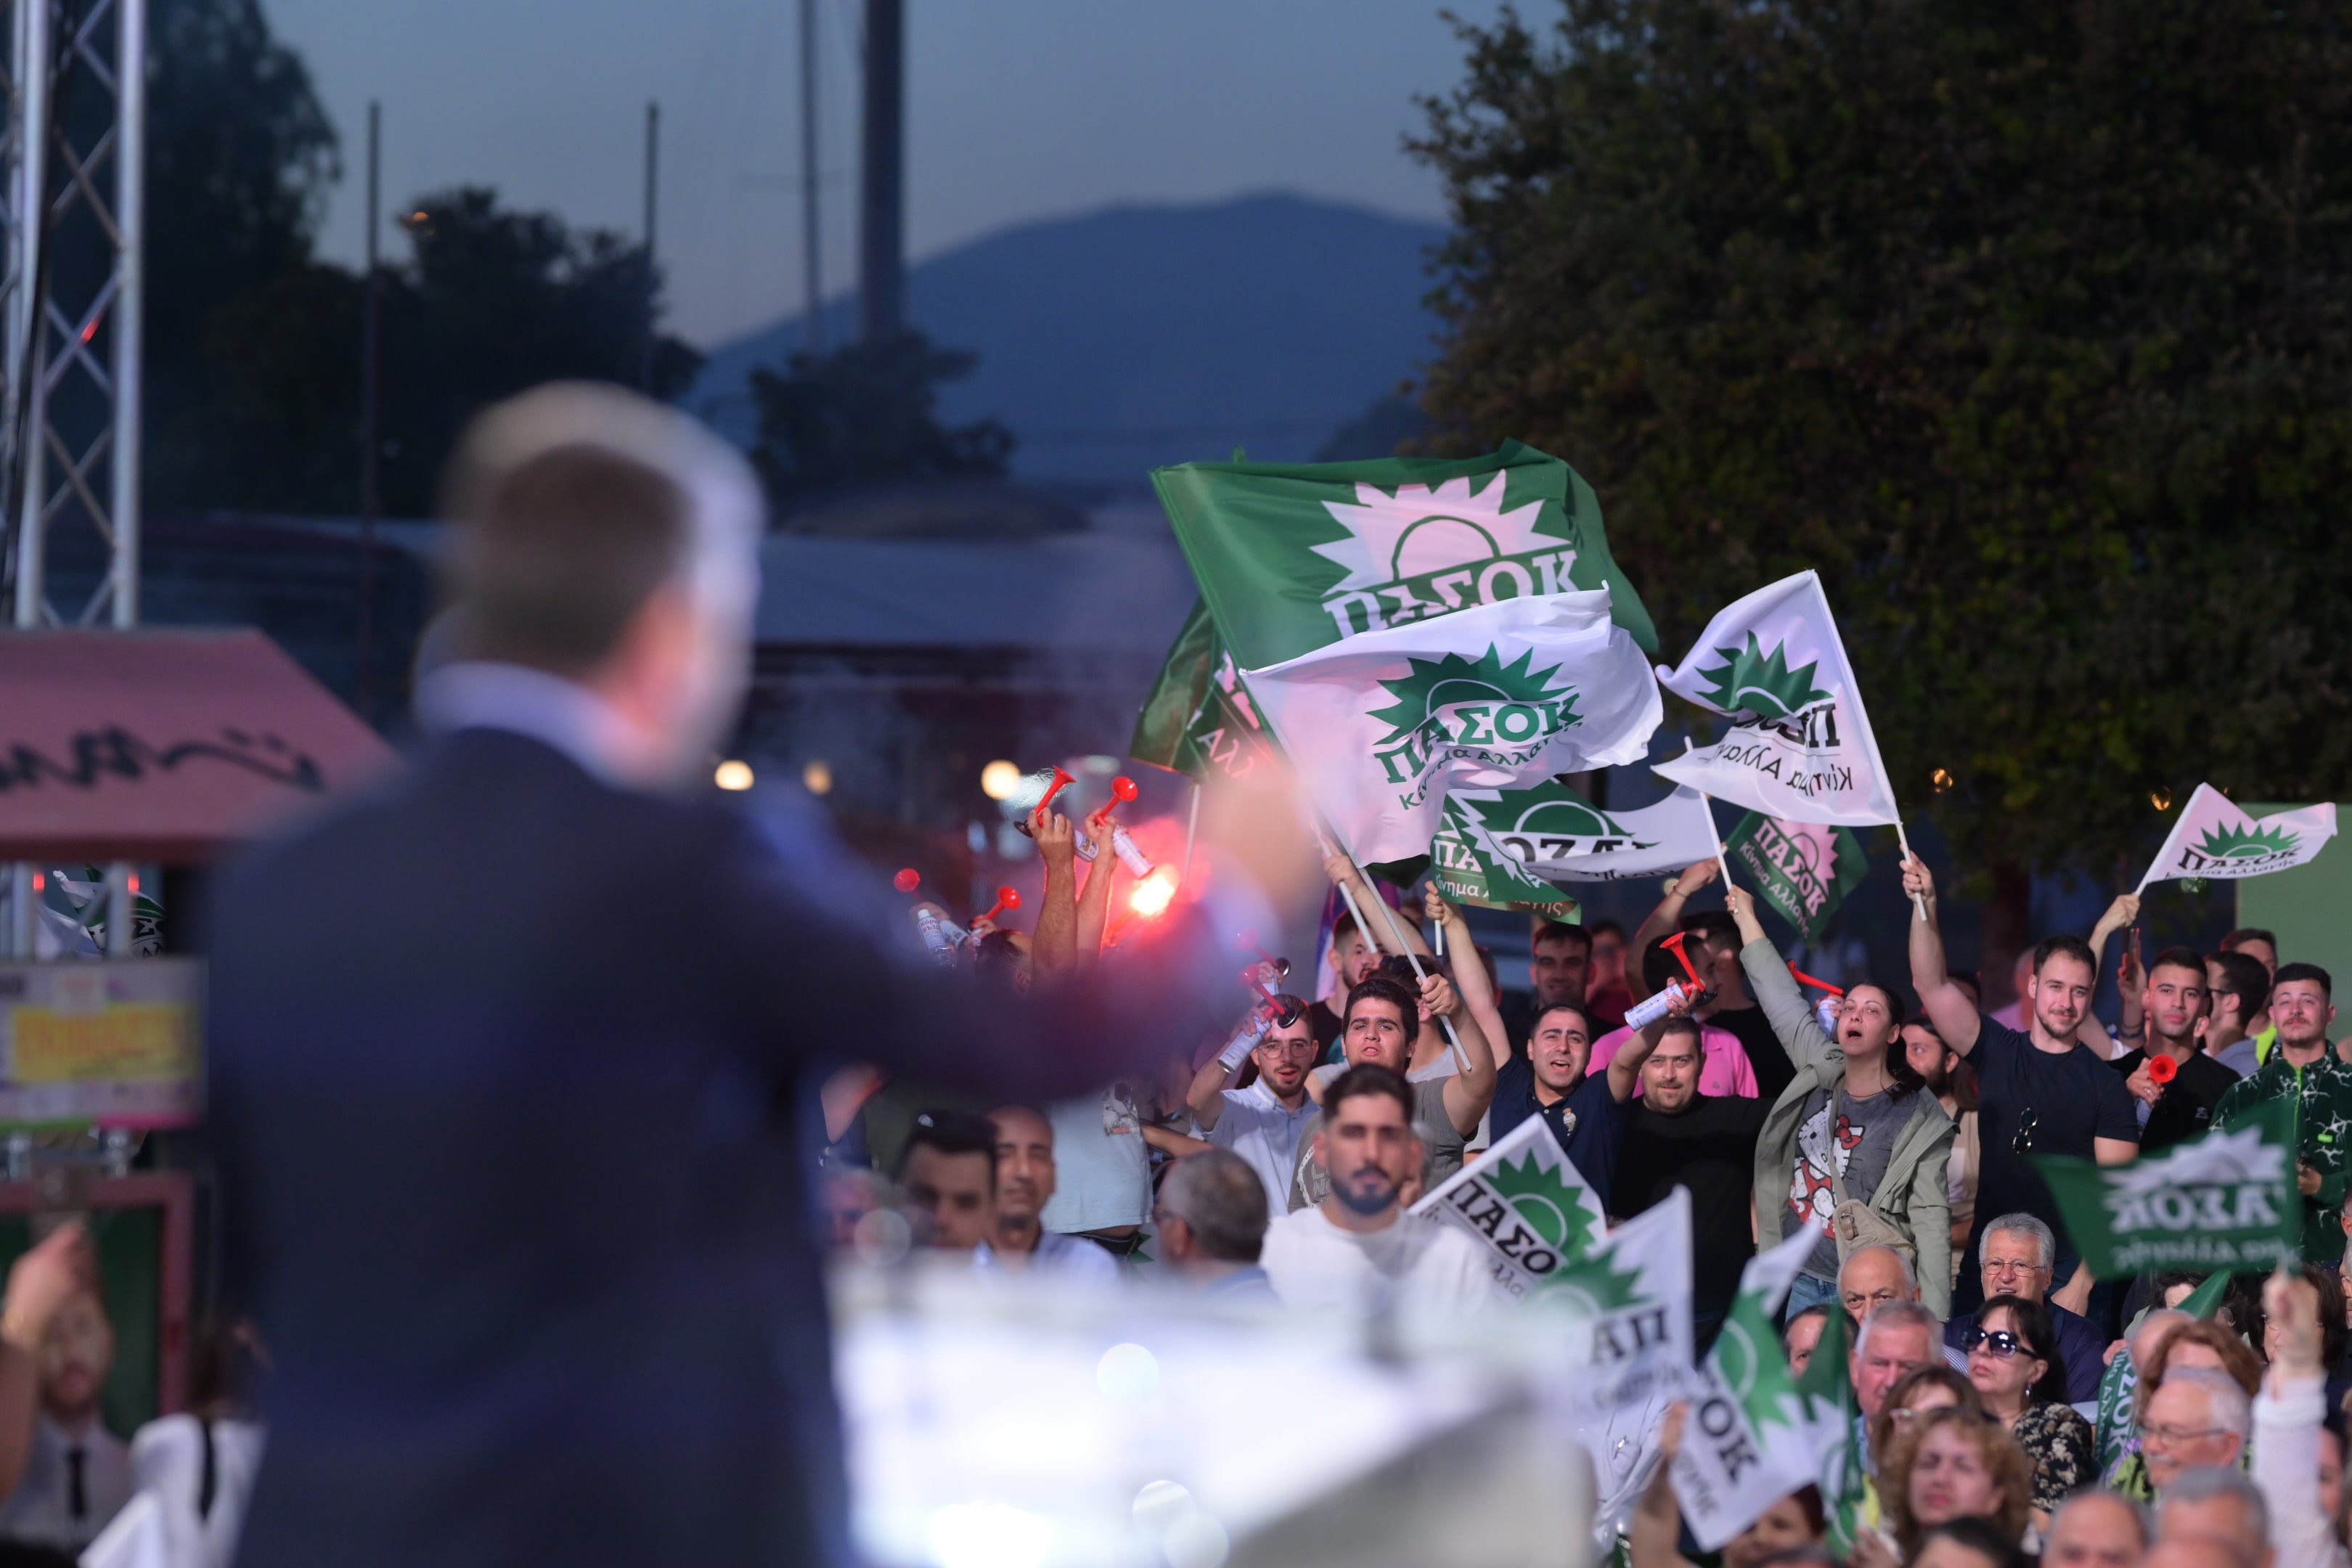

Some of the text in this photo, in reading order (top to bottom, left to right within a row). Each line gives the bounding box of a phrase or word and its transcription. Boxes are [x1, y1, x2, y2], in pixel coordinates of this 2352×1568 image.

[1321, 550, 1580, 639] ΠΑΣΟΚ
[1373, 693, 1584, 784] ΠΑΣΟΚ
[1399, 748, 1471, 810] Κίνμα
[1740, 841, 1771, 886] Κίνημα
[1754, 819, 1826, 917] ΠΑΣΟΚ
[2178, 846, 2303, 871] ΠΑΣΟΚ
[1447, 1179, 1556, 1274] ΠΑΣΟ
[2104, 1362, 2139, 1455] ΣΟΚ
